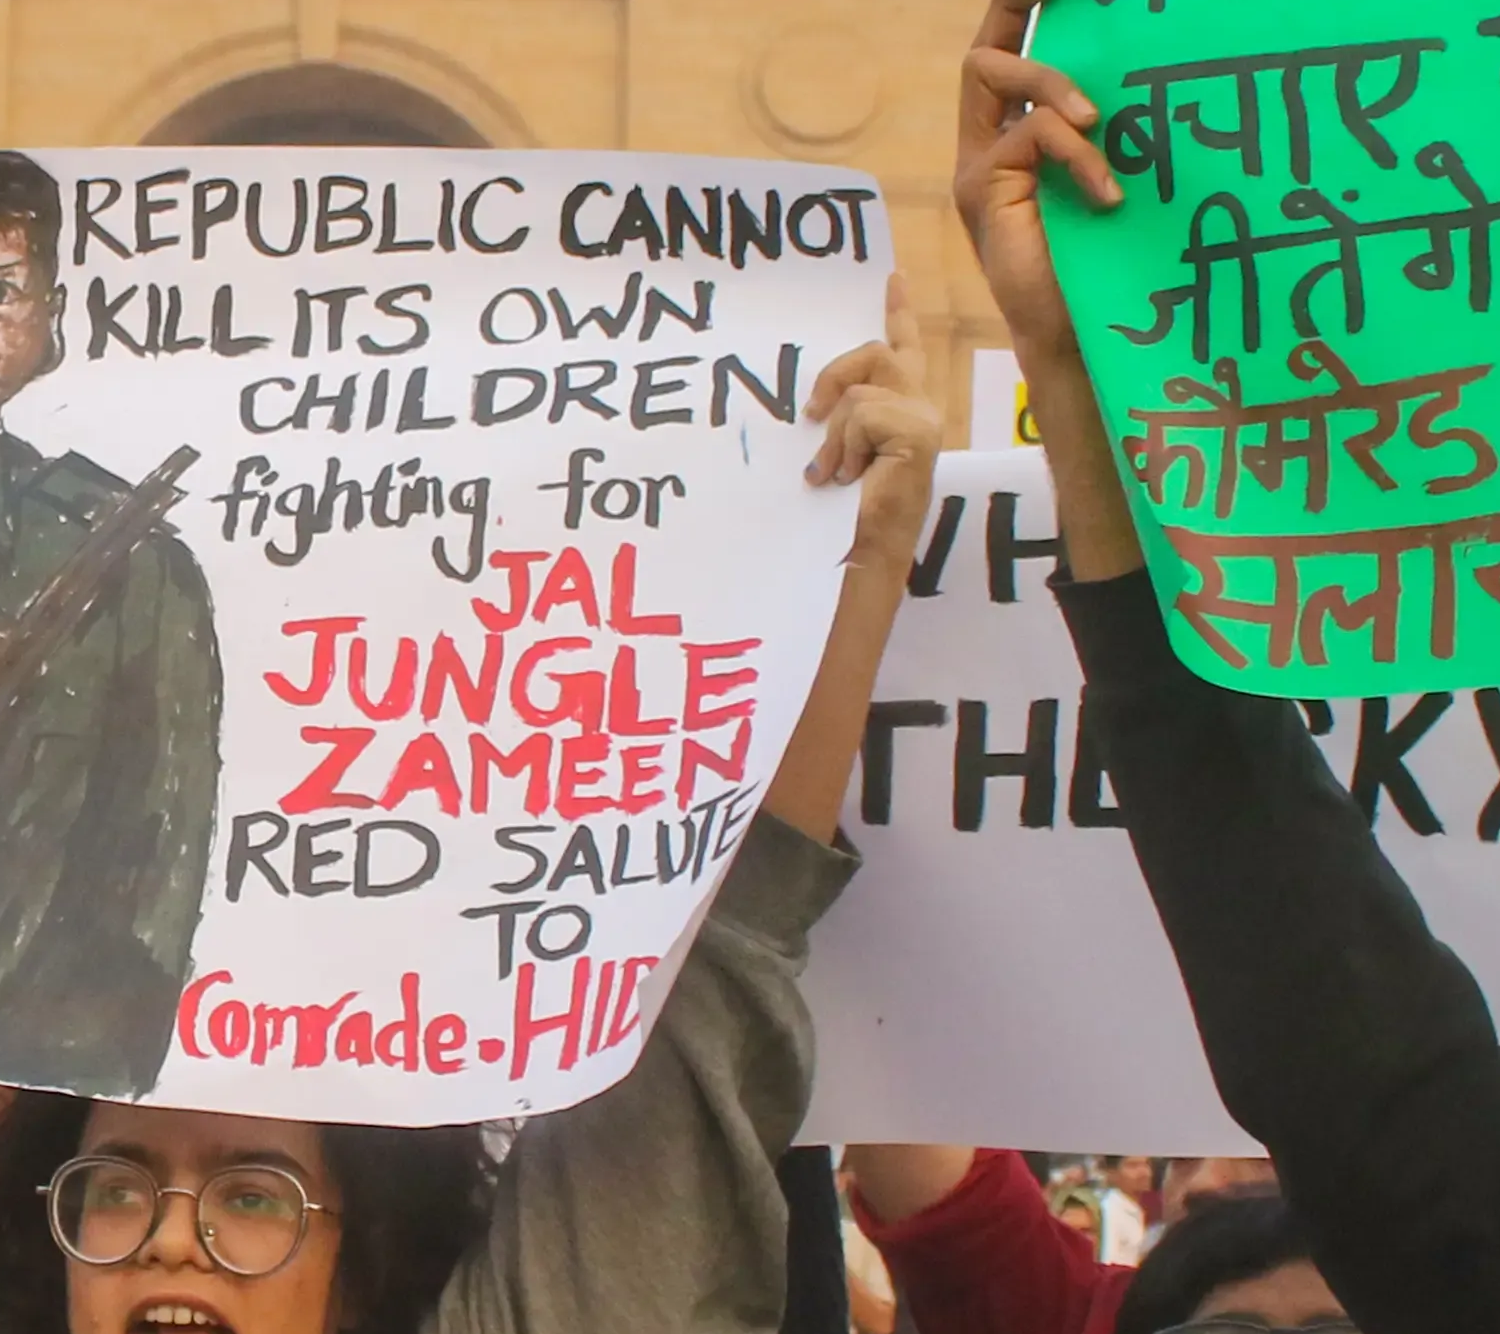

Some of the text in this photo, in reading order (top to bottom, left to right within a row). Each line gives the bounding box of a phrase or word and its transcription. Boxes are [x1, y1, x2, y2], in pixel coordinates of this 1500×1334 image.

[72, 175, 878, 269] REPUBLIC CANNOT
[85, 271, 716, 362] KILL ITS OWN
[238, 343, 803, 437] CHILDREN
[208, 447, 687, 584] fighting for
[471, 542, 684, 633] JAL
[261, 614, 764, 737] JUNGLE
[277, 715, 754, 822] ZAMEEN
[224, 779, 765, 904] RED SALUTE
[458, 899, 595, 980] TO
